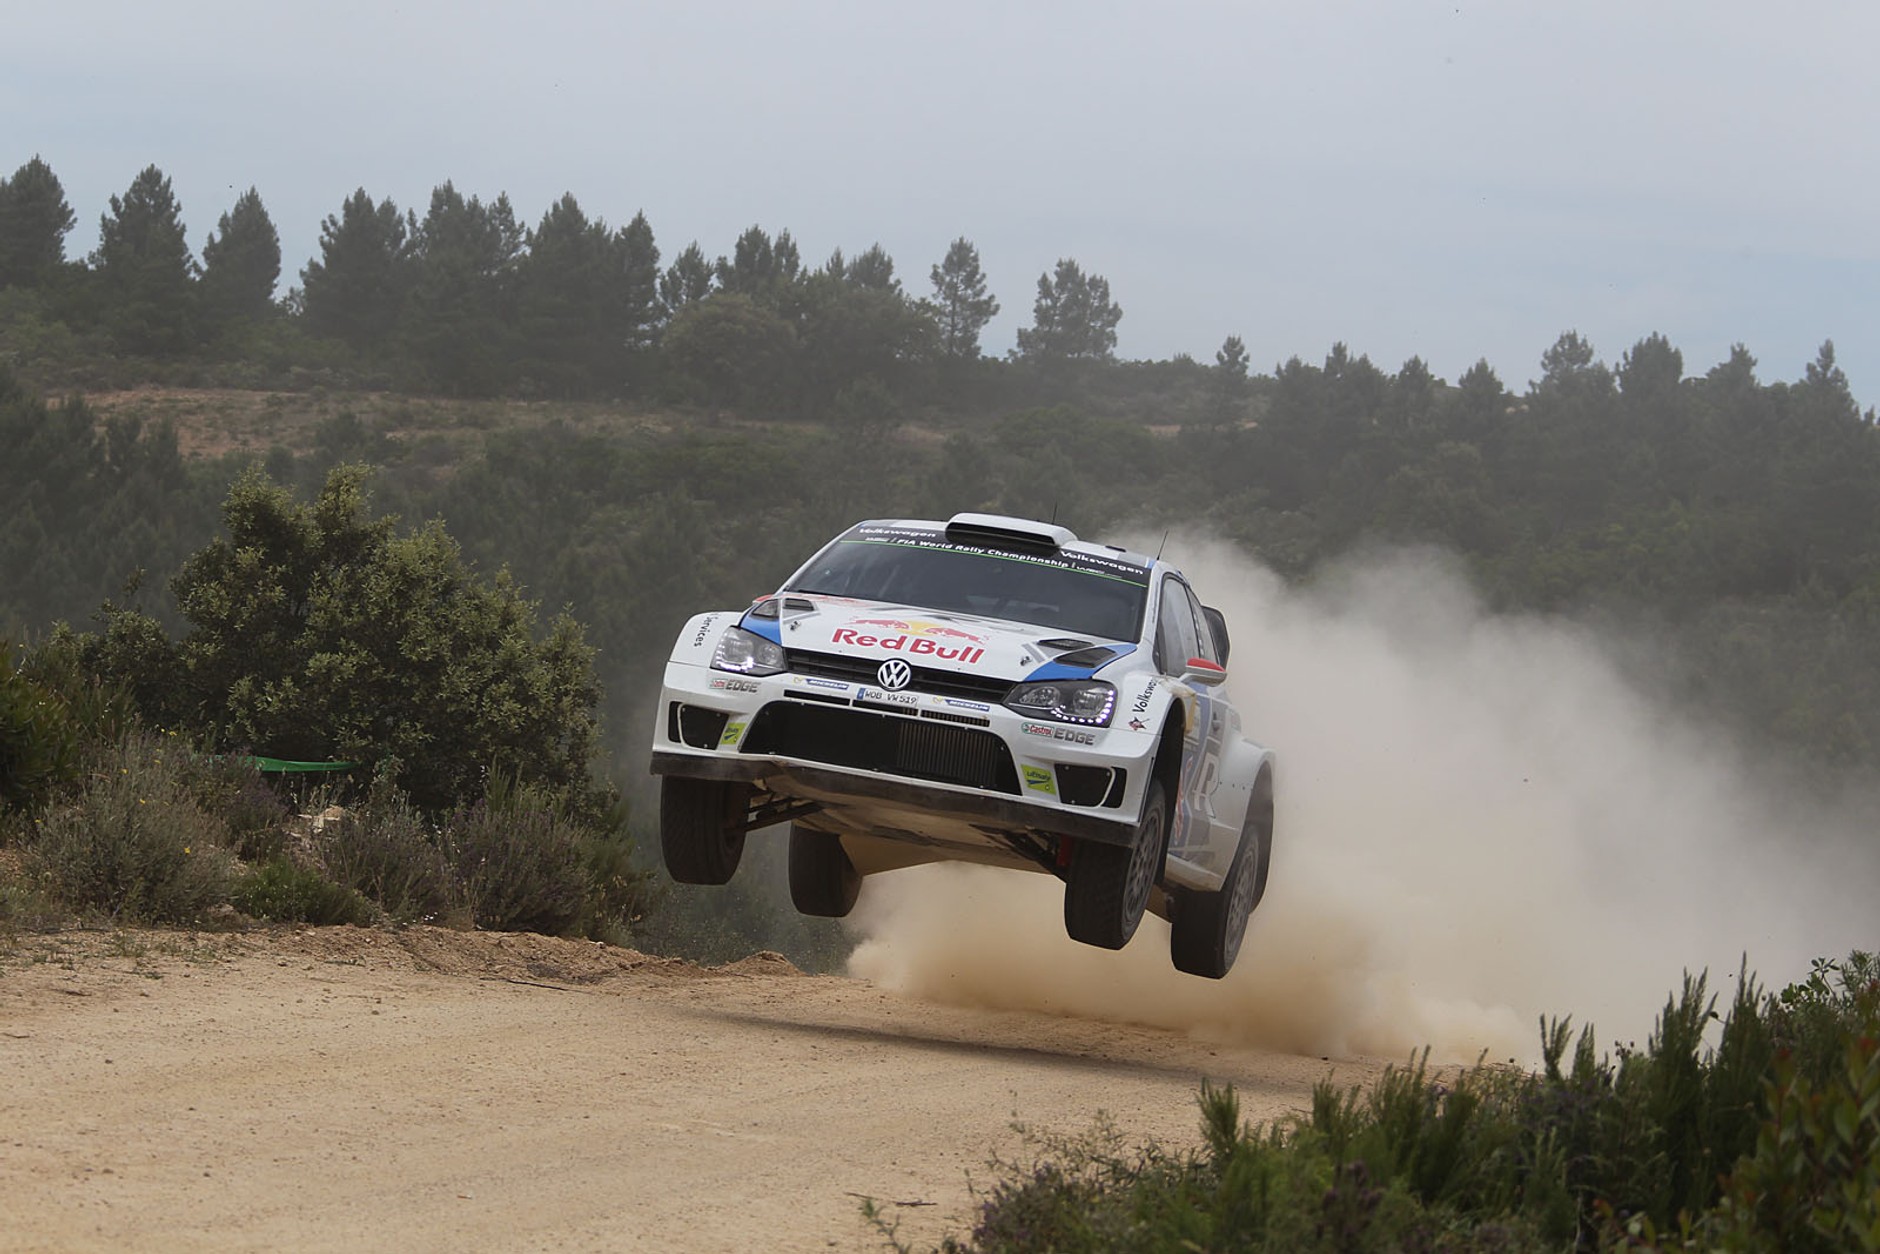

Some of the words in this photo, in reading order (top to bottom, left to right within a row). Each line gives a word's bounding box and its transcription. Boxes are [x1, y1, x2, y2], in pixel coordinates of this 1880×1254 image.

[860, 527, 936, 538] Volkswagen
[897, 538, 916, 546] FIA
[919, 540, 953, 550] World
[955, 544, 985, 554] Rally
[987, 549, 1069, 568] Championship
[1060, 550, 1143, 575] Volkswagen
[832, 628, 907, 650] Red
[909, 638, 985, 664] Bull
[725, 679, 762, 694] EDGE
[865, 690, 883, 699] WOB
[1054, 727, 1096, 746] EDGE
